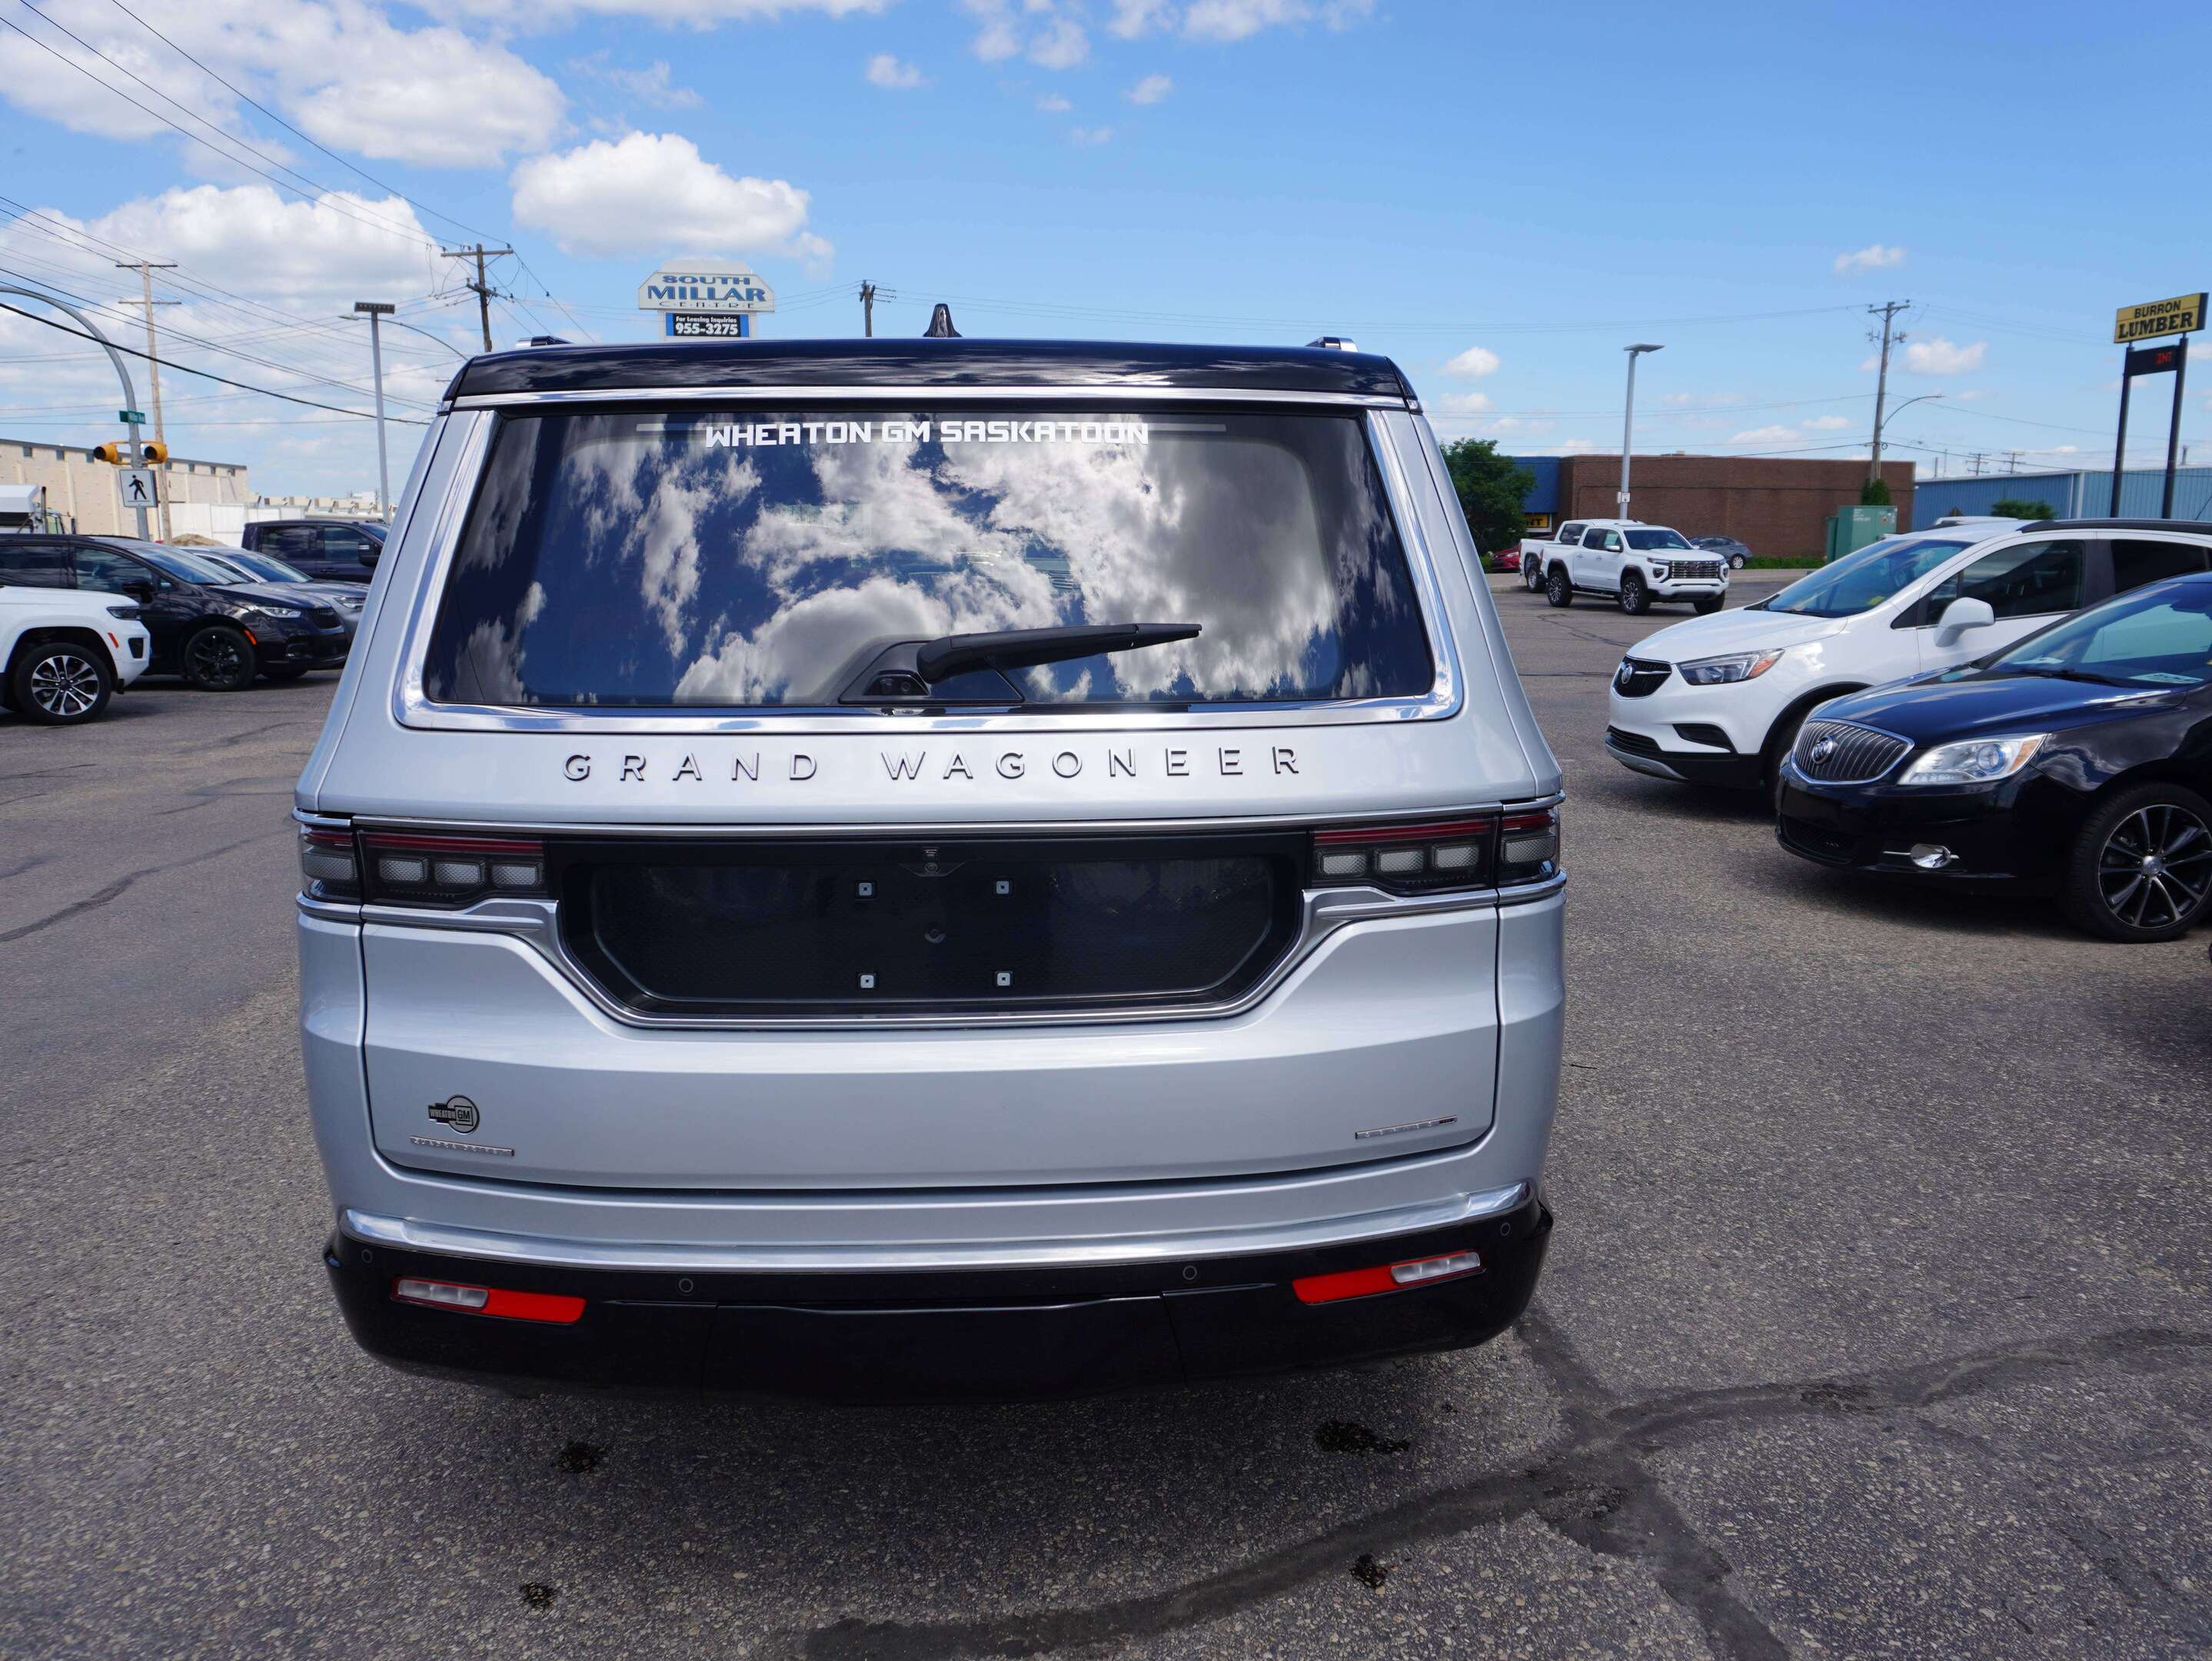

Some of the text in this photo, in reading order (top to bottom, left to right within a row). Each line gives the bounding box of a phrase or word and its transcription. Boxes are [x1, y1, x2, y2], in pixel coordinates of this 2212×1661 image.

[663, 275, 750, 285] SOUTH
[647, 286, 767, 301] MILLAR
[2134, 300, 2181, 318] BURRON
[675, 323, 738, 335] 955-3275
[2118, 311, 2194, 338] LUMBER
[705, 421, 1149, 448] WHEATON GM SASKATOON
[562, 746, 1301, 782] GRAND WAGONEER
[429, 1108, 471, 1120] WHEATON GM
